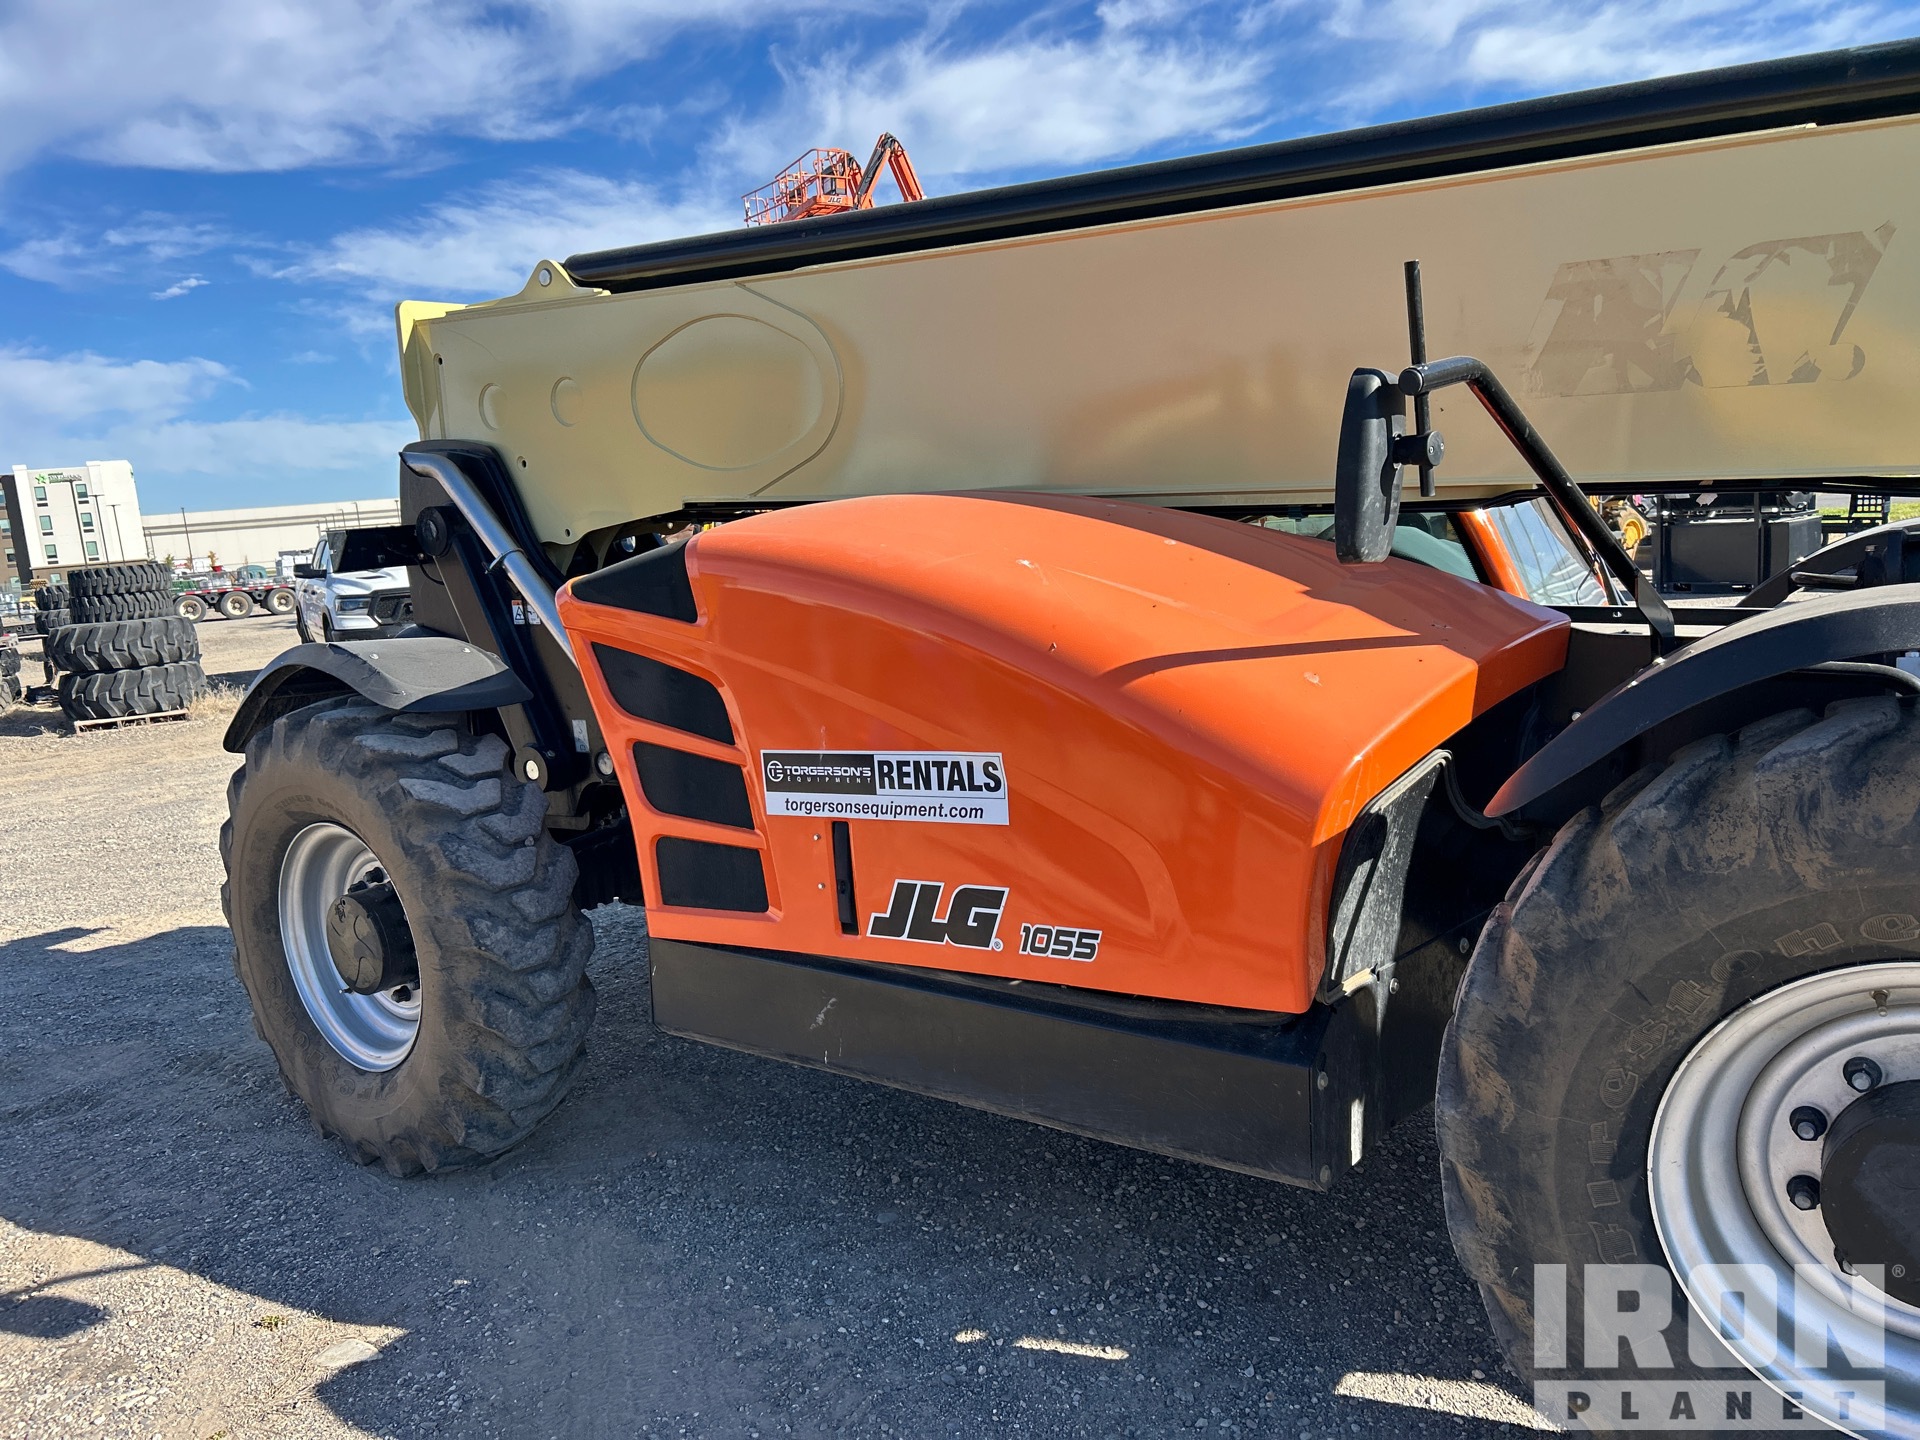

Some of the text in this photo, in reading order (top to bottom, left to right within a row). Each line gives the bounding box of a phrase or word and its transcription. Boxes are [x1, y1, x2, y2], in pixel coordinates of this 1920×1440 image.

[784, 766, 871, 776] TORGERSON'S
[877, 760, 1002, 792] RENTALS
[785, 798, 984, 819] torgersonsequipment.com
[868, 880, 1009, 950] JLG
[1019, 924, 1101, 961] 1055
